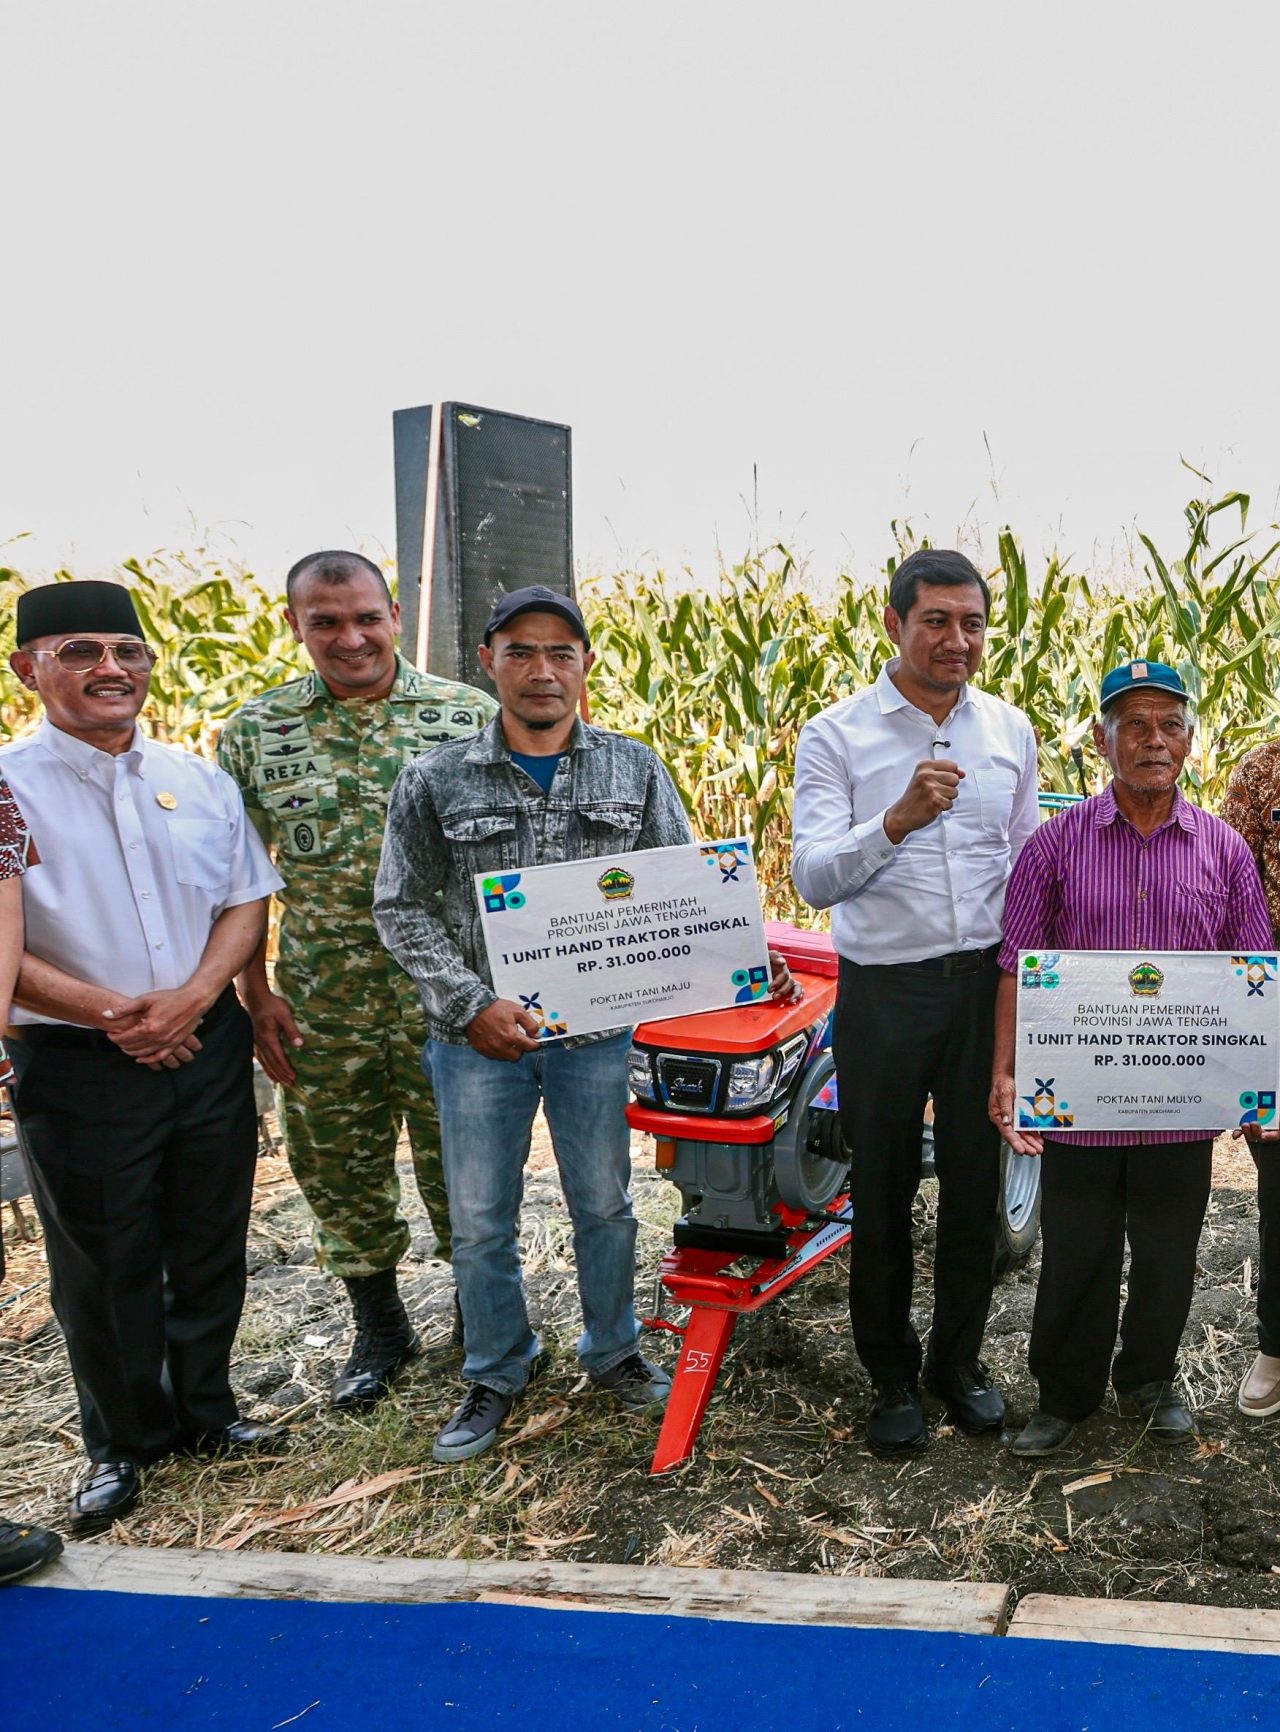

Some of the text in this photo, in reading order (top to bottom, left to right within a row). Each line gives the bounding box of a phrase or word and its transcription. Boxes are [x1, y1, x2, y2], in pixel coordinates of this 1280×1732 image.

[264, 761, 317, 782] REZA
[550, 896, 697, 928] BANTUAN PEMERINTAH
[547, 906, 707, 940] PROVINSI JAWA TENGAH
[502, 916, 750, 965] 1 UNIT HAND TRAKTOR SINGKAL
[577, 944, 691, 973] RP. 31.000.000
[590, 981, 691, 1006] POKTAN TANI MAJU
[610, 1001, 641, 1010] KABUPATEN
[1077, 1004, 1220, 1015] BANTUAN PEMERINTAH
[1073, 1016, 1227, 1027] PROVINSI JAWA TENGAH
[1027, 1033, 1267, 1046] 1 UNIT HAND TRAKTOR SINGKAL
[1094, 1054, 1206, 1066] RP. 31.000.000
[1097, 1095, 1202, 1104] POKTAN TANI MULYO
[685, 1349, 712, 1370] 55
